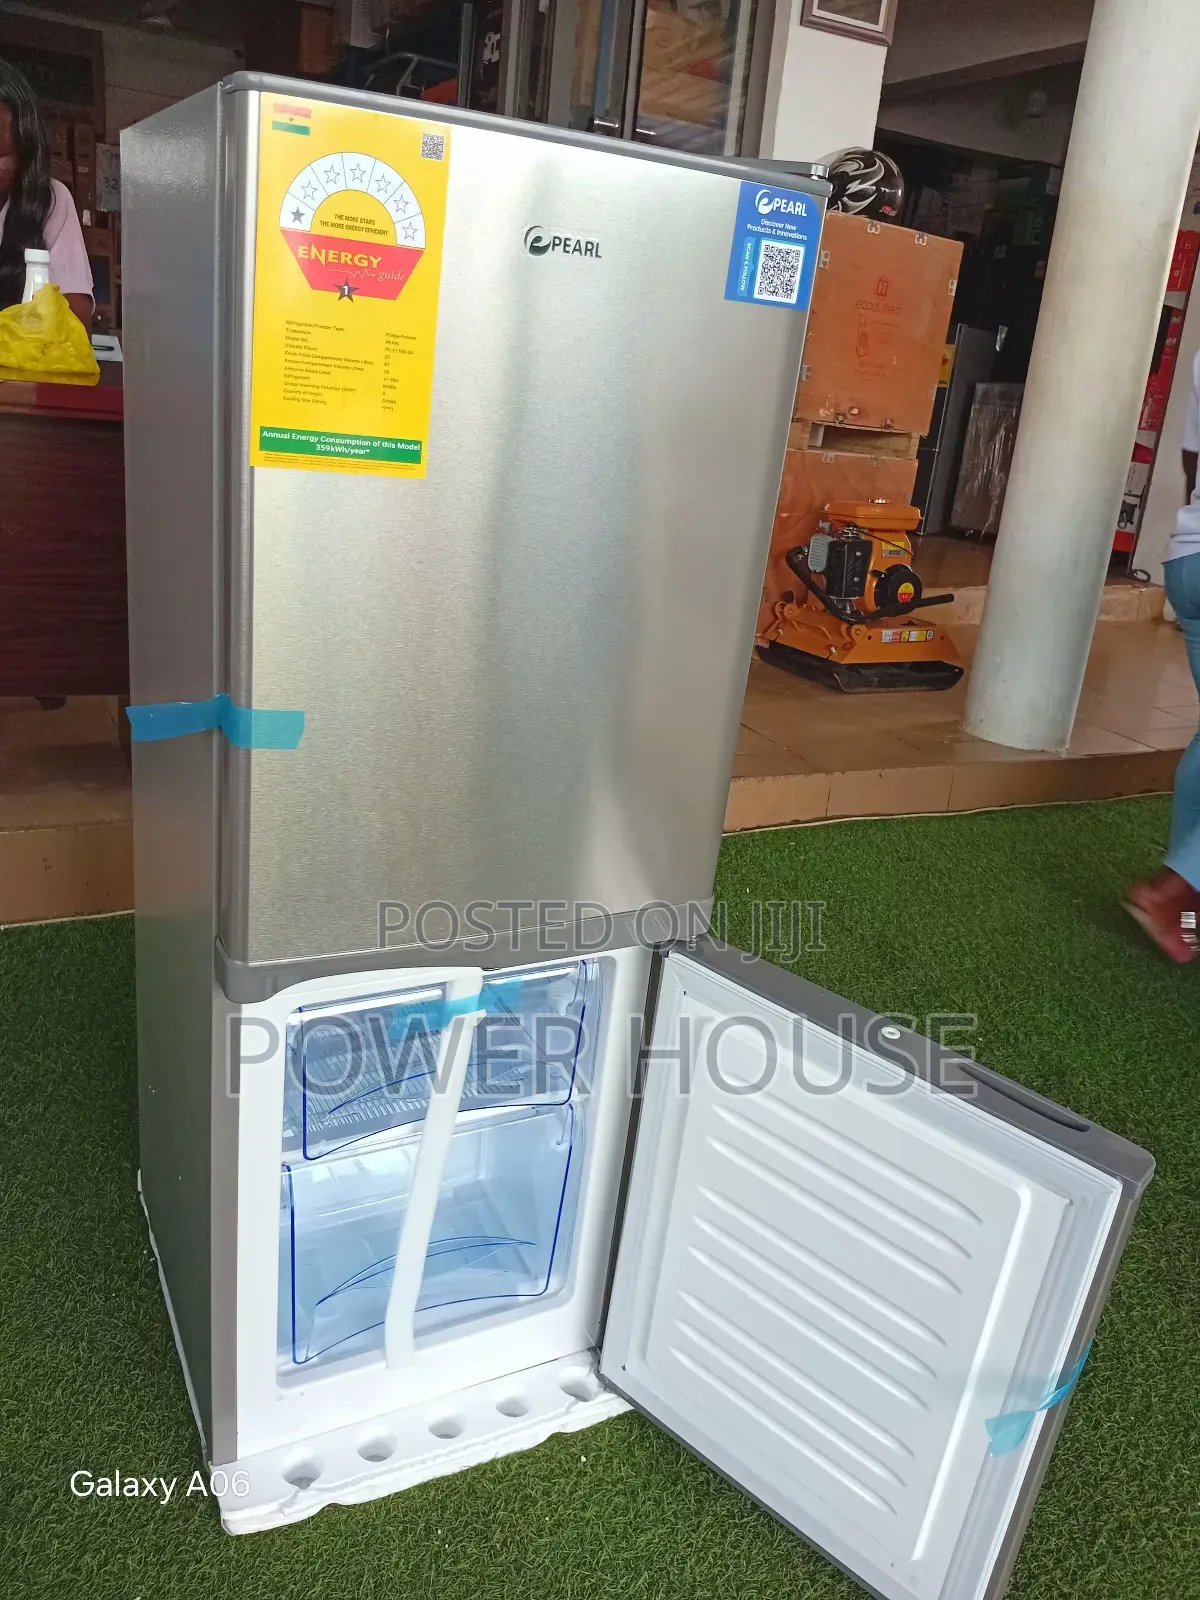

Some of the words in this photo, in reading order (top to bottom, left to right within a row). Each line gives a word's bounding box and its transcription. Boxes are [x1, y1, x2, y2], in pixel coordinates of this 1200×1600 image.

[334, 213, 345, 221] THE
[345, 215, 359, 223] MORE
[360, 217, 376, 226] STARS
[761, 218, 785, 229] Discover
[784, 223, 797, 231] New
[320, 220, 330, 228] THE
[330, 222, 345, 230] MORE
[345, 224, 364, 233] ENERGY
[365, 227, 389, 236] EFFICIENT
[746, 223, 772, 235] Products
[776, 229, 808, 241] Innovations
[298, 243, 383, 269] ENERGY
[744, 242, 752, 261] SCAN
[378, 270, 406, 282] guide
[740, 267, 749, 292] FOLLOW
[343, 285, 349, 296] 1
[301, 360, 333, 368] Compartment
[311, 353, 342, 362] Compartment
[283, 388, 302, 396] Country
[299, 382, 320, 390] Warming
[283, 395, 301, 403] Cooling
[262, 430, 290, 440] Annual
[292, 432, 319, 443] Energy
[320, 435, 371, 447] Consumption
[382, 441, 396, 449] this
[397, 442, 421, 451] Model
